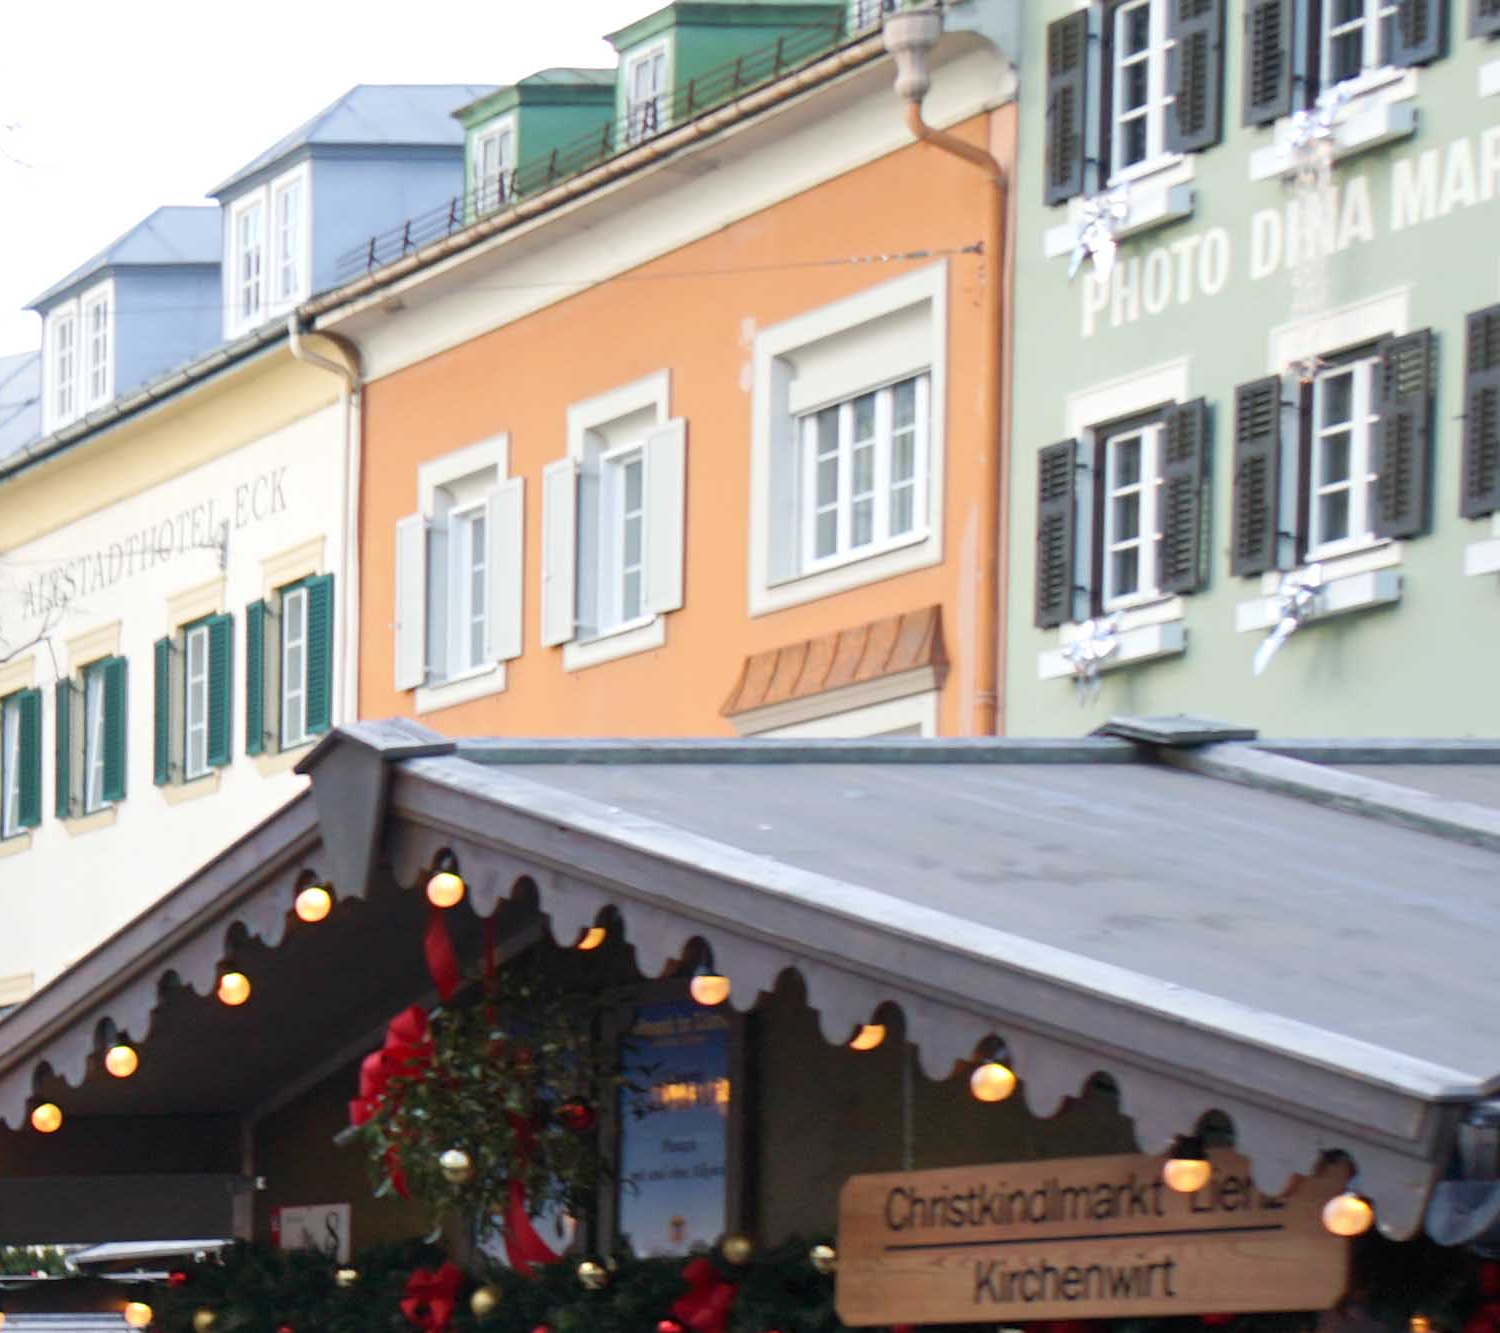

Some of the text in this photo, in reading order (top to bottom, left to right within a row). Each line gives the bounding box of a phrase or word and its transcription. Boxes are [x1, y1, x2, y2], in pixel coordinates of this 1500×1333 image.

[1081, 227, 1231, 338] PHOTO
[235, 466, 287, 529] ECK
[884, 1172, 1165, 1232] Christkindlmarkt
[973, 1254, 1177, 1306] Kirchenwirt
